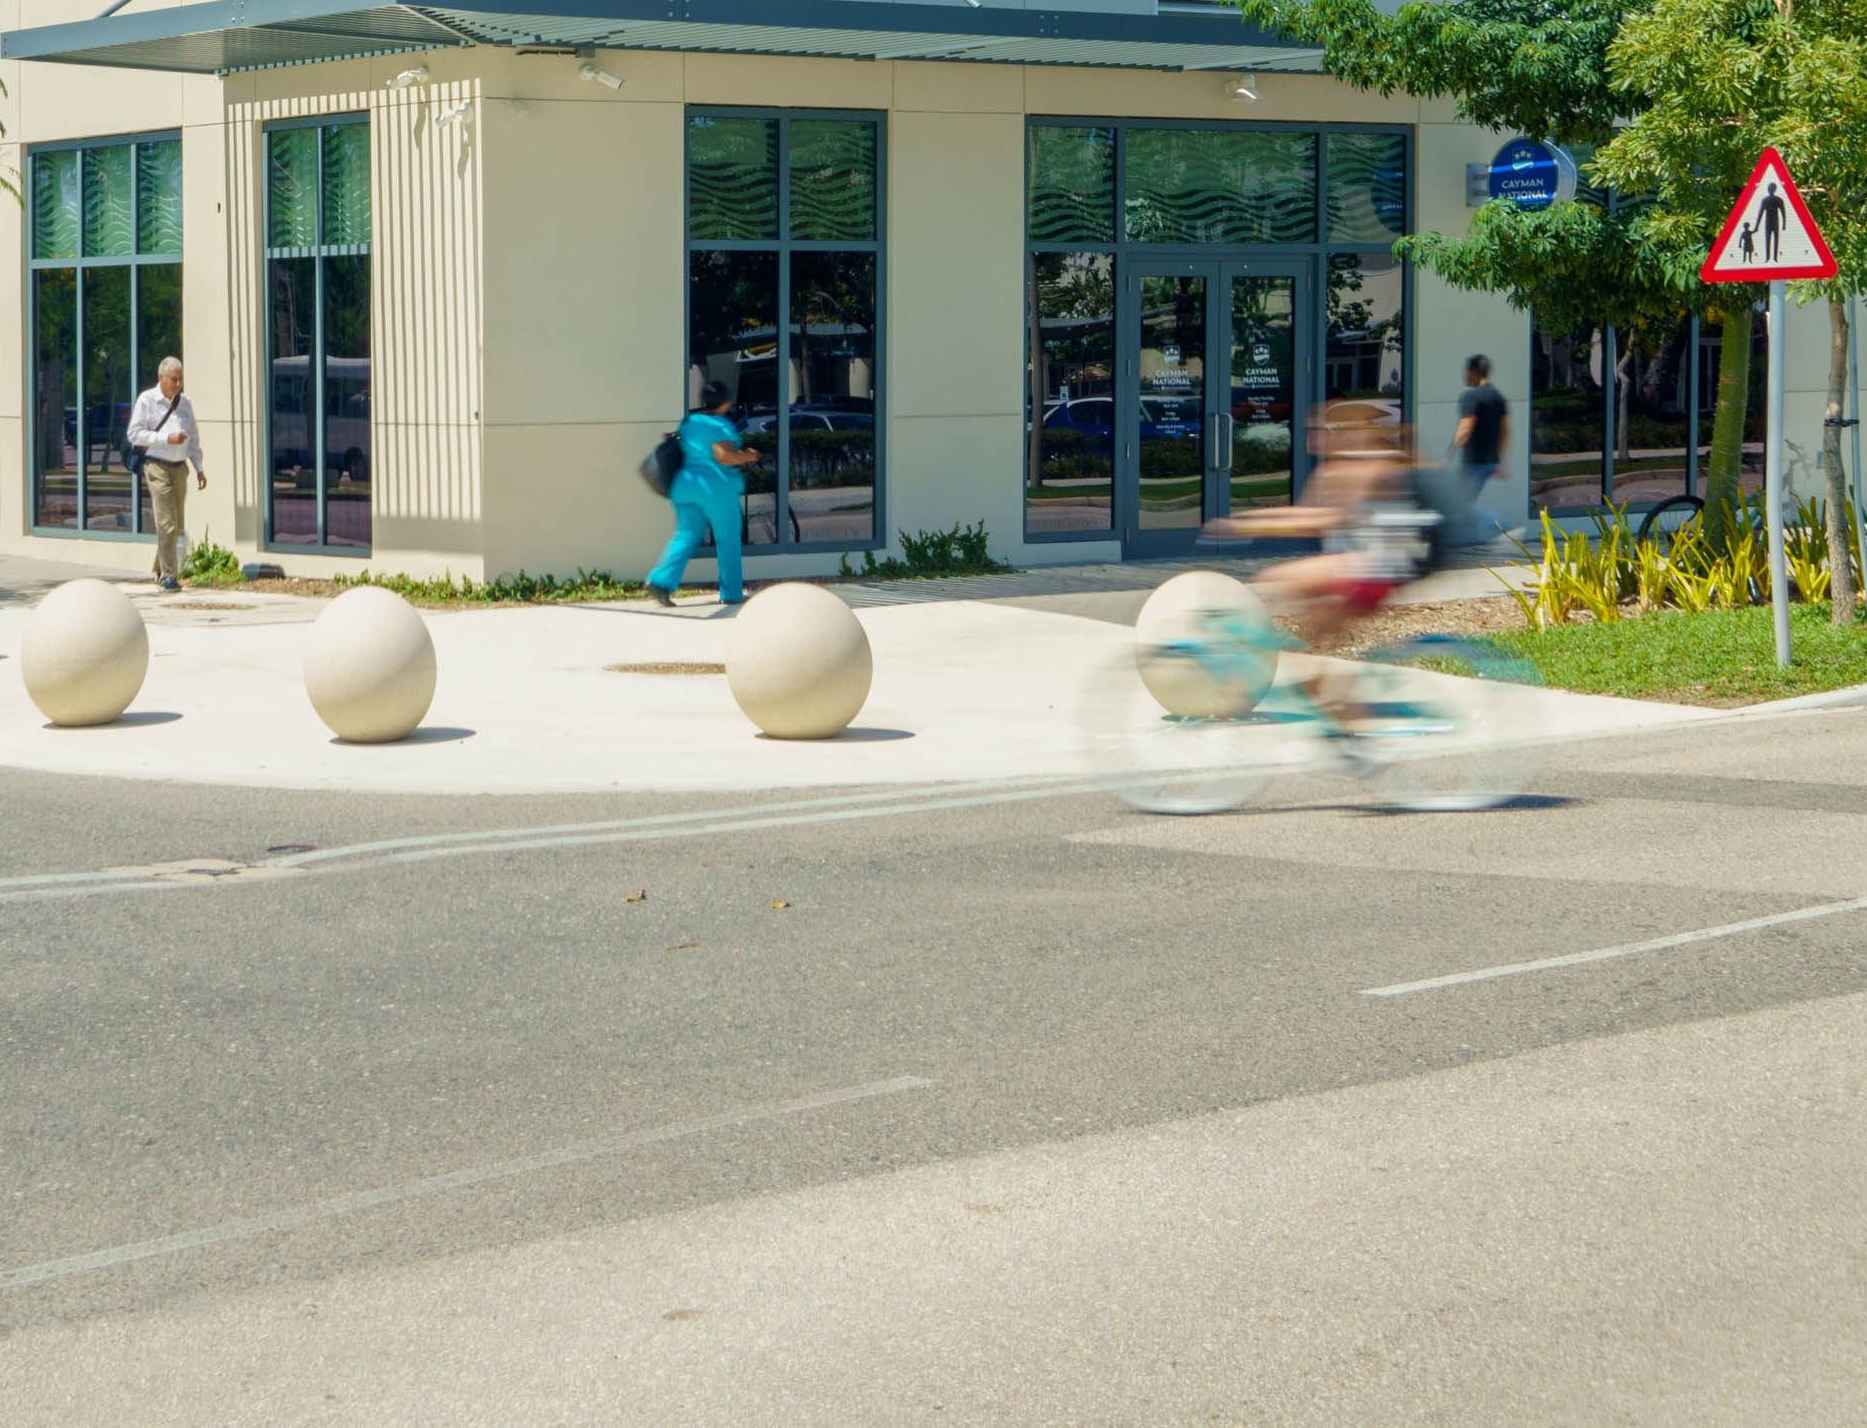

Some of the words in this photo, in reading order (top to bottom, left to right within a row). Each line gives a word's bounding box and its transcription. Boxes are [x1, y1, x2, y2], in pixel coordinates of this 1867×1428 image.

[1501, 178, 1544, 189] CAYMAN
[1498, 189, 1548, 200] NATIONAL
[1155, 369, 1189, 377] CAYMAN
[1245, 368, 1277, 376] CAYMAN
[1152, 377, 1190, 386] NATIONAL
[1243, 376, 1280, 384] NATIONAL
